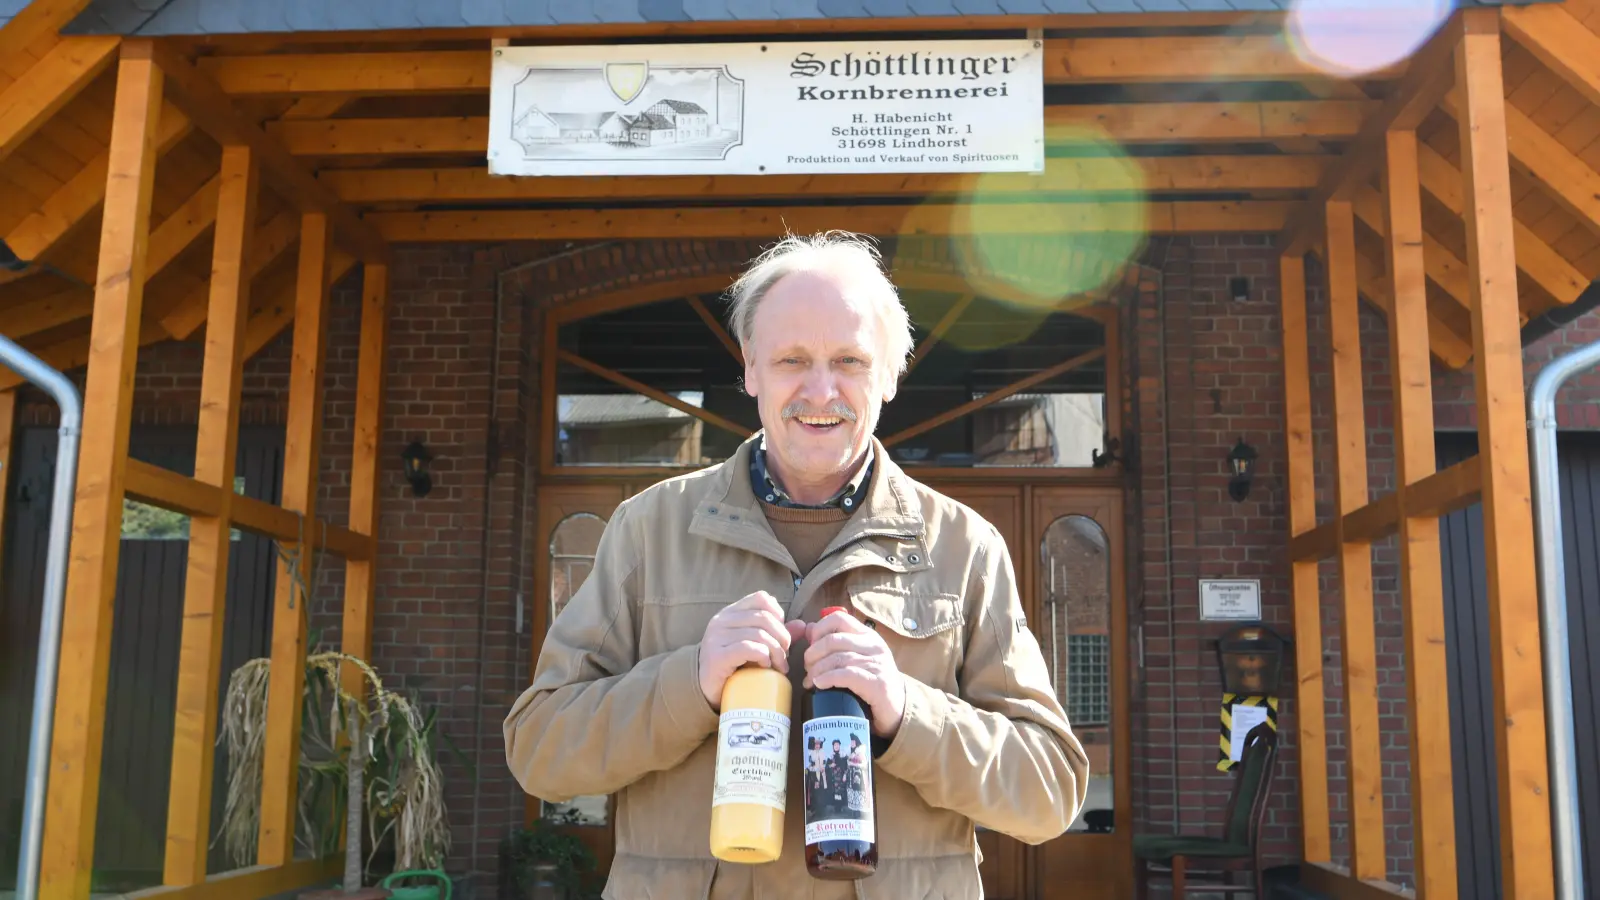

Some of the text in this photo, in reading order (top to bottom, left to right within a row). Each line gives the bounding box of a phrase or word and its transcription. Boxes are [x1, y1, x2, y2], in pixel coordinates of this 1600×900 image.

[790, 51, 1016, 81] Schöttlinger
[797, 82, 1009, 101] Kornbrennerei
[851, 112, 953, 124] H. Habenicht
[831, 124, 973, 139] Schöttlingen Nr. 1
[837, 137, 968, 150] 31698 Lindhorst
[786, 152, 1020, 164] Produktion und Verkauf von Spirituosen
